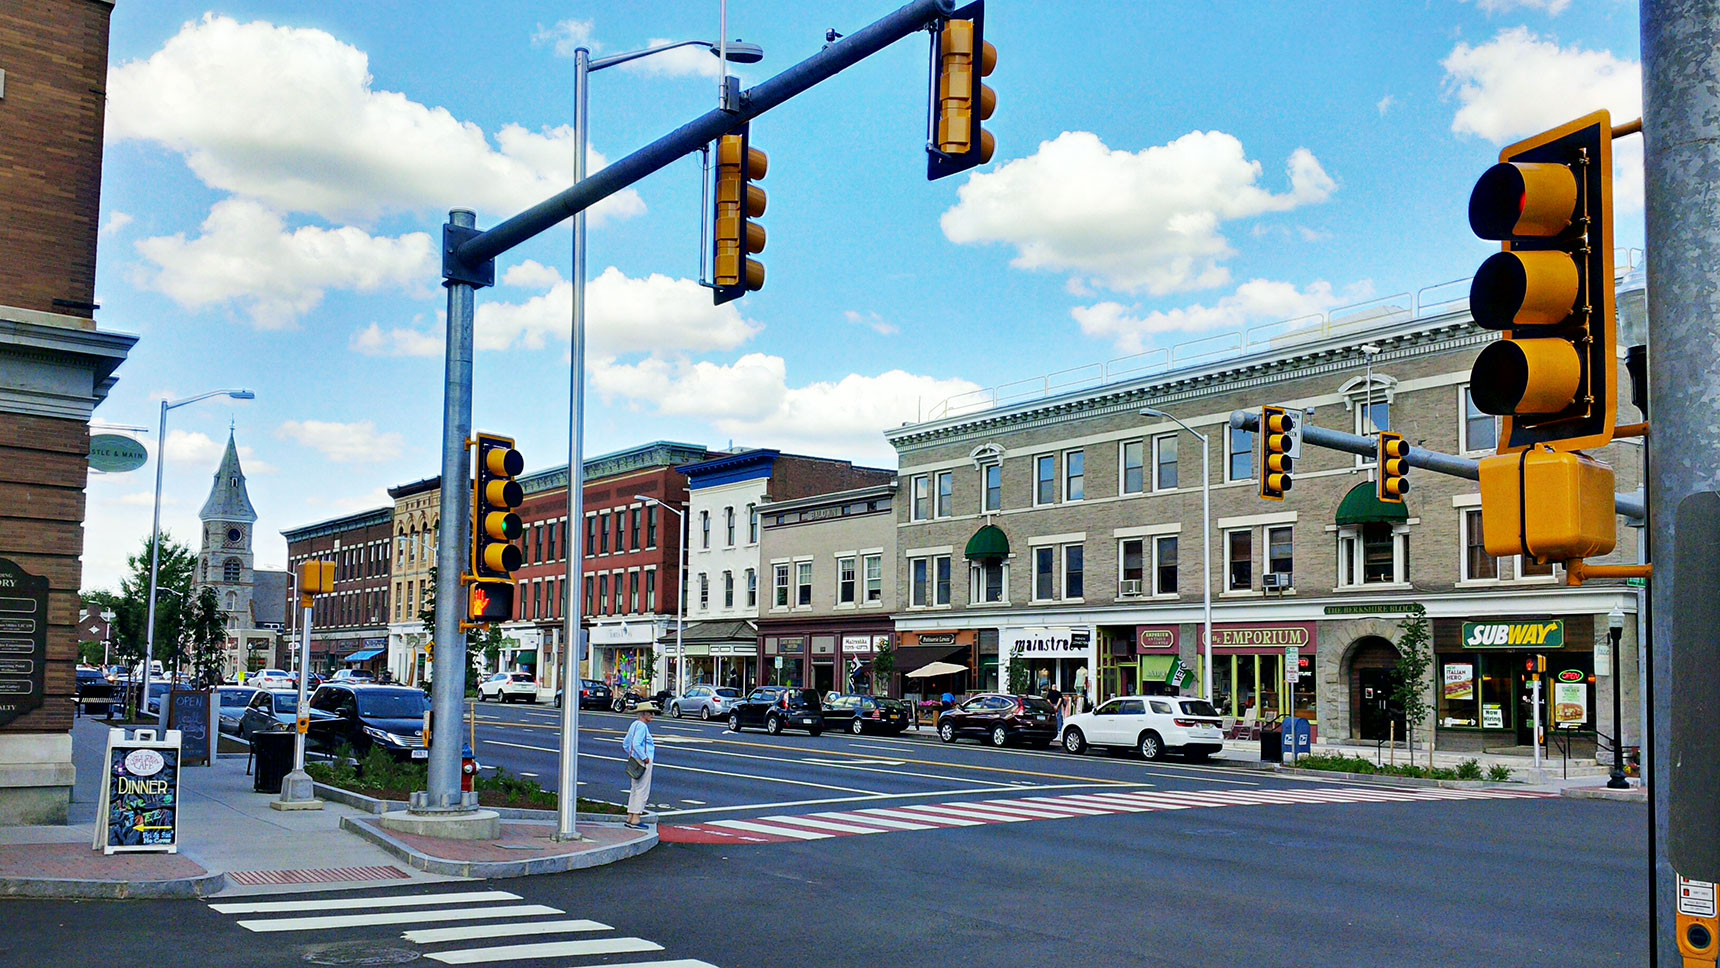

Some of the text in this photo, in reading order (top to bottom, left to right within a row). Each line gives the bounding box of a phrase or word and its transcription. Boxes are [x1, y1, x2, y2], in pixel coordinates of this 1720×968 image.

[122, 451, 144, 460] MAIN
[0, 579, 17, 588] RY
[1343, 605, 1387, 613] BERKSHIRE
[1223, 630, 1302, 644] EMPORIUM
[1467, 622, 1558, 646] SUBWAY
[1561, 671, 1580, 680] OPEN
[176, 695, 203, 707] OPEN
[118, 776, 168, 795] DINNER
